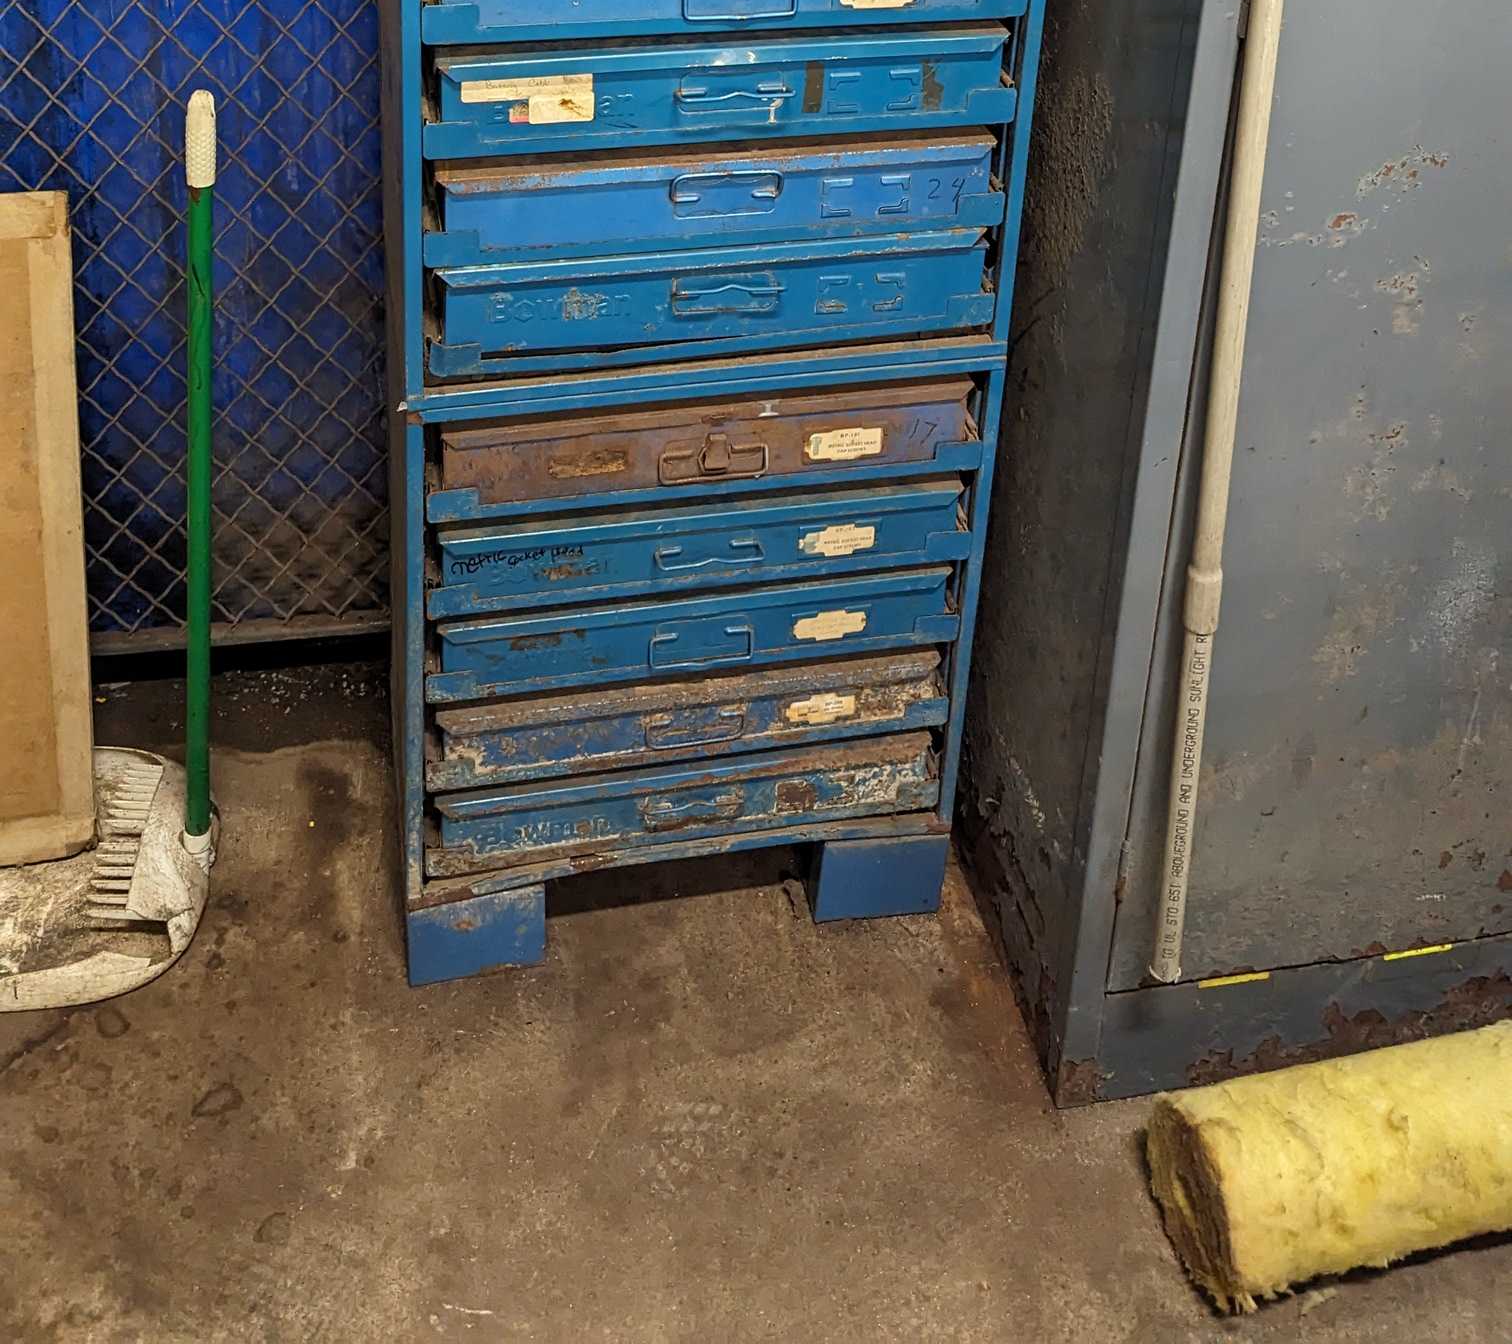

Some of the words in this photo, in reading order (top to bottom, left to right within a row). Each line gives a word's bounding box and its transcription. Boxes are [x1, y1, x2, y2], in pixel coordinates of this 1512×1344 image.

[909, 418, 938, 444] 17
[1190, 650, 1207, 703] SUNLIGHT
[1181, 708, 1200, 779] UNDERGROUND
[1178, 784, 1192, 804] AND
[1171, 809, 1189, 878] ABOVEGROUND
